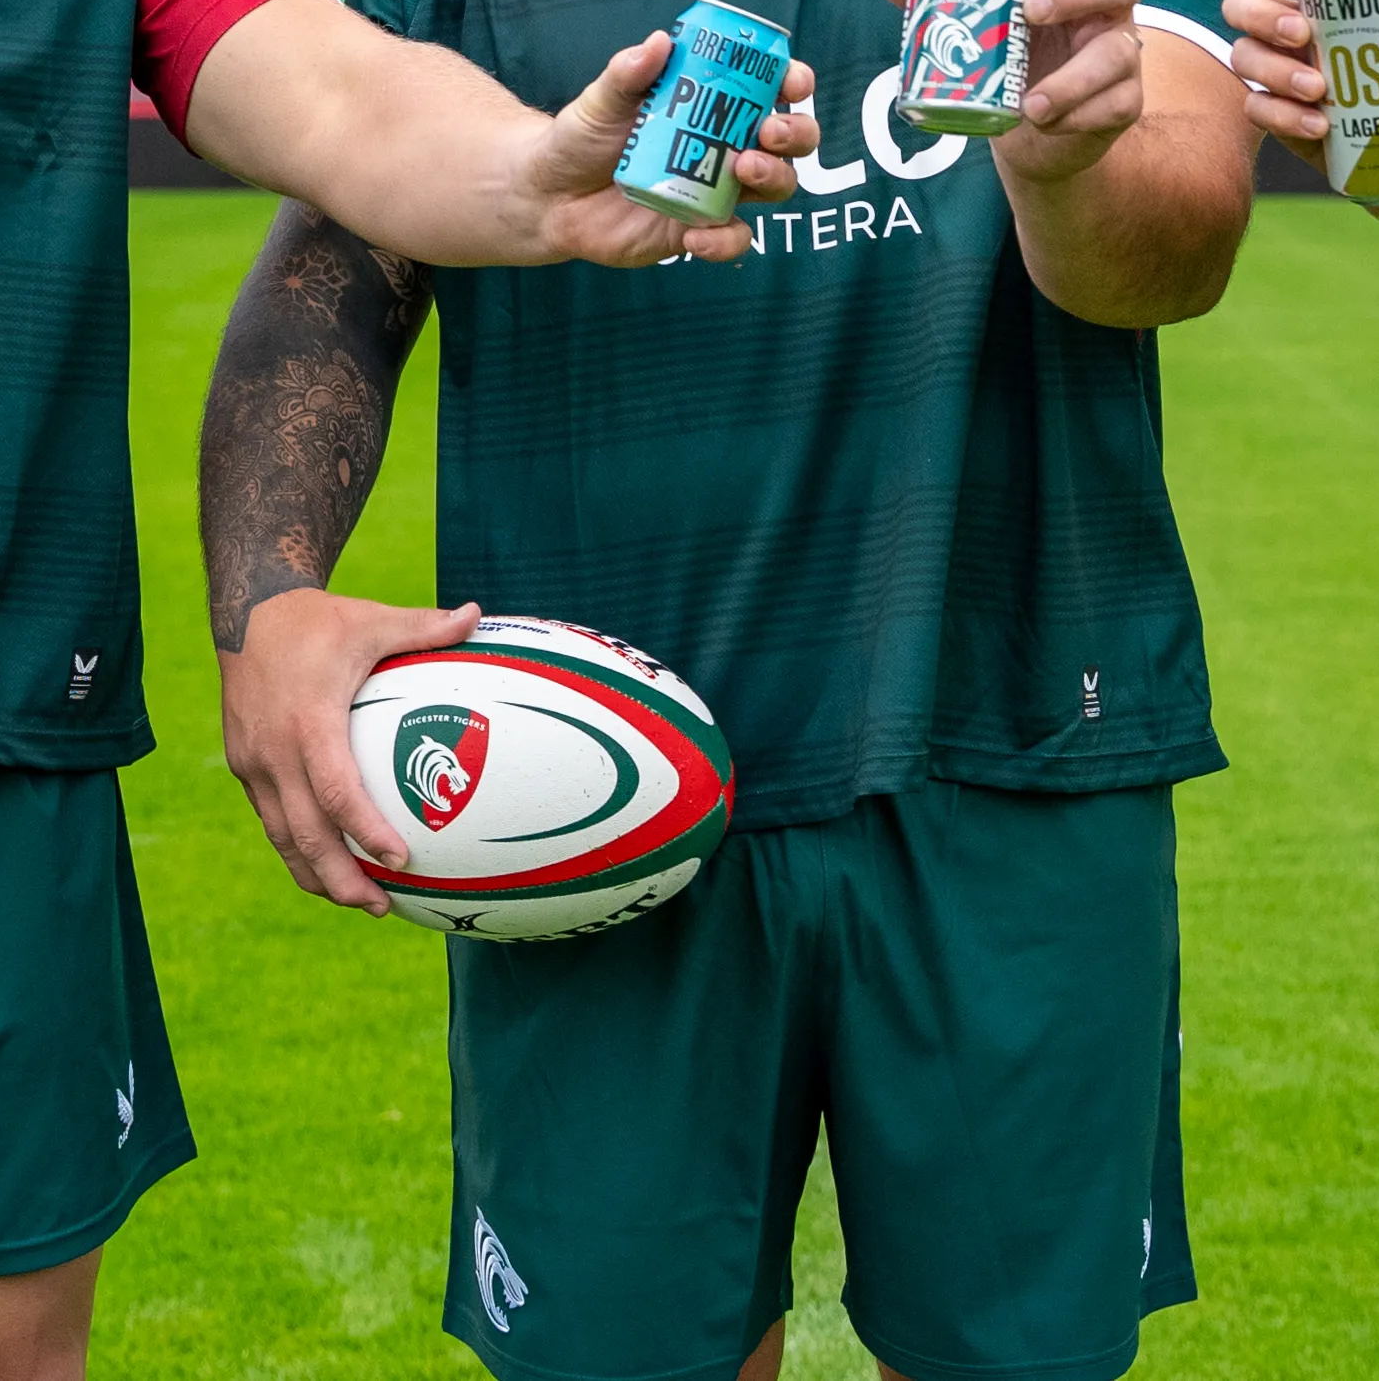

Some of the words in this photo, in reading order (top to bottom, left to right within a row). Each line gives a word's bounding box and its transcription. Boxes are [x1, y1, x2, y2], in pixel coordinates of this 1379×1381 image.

[692, 27, 779, 84] BREWDOG
[1002, 3, 1030, 110] BREWED
[666, 76, 764, 152] PUNK
[775, 65, 968, 195] LO
[672, 134, 719, 182] IPA
[402, 714, 450, 728] LEICESTER
[453, 715, 486, 731] TIGERS
